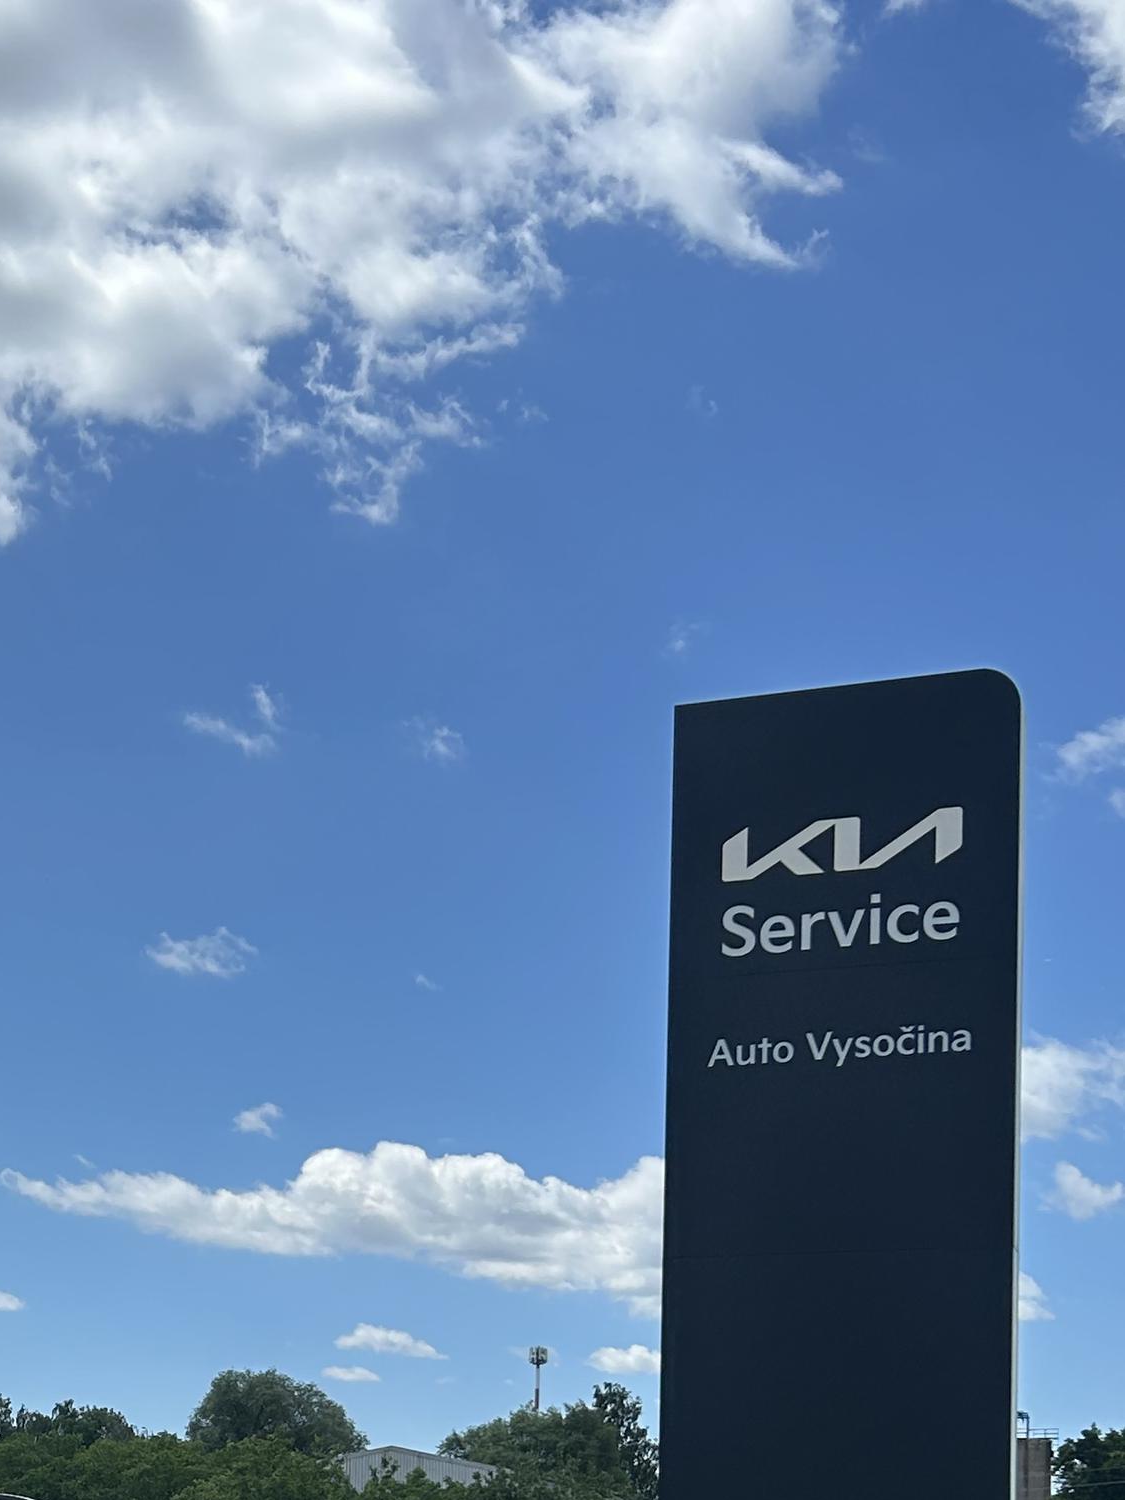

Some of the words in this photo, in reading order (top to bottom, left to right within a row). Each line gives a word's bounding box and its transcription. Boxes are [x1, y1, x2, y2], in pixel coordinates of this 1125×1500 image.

[721, 806, 963, 882] KIA
[721, 893, 961, 958] Service
[707, 1037, 795, 1068] Auto
[805, 1024, 973, 1067] Vysočina
